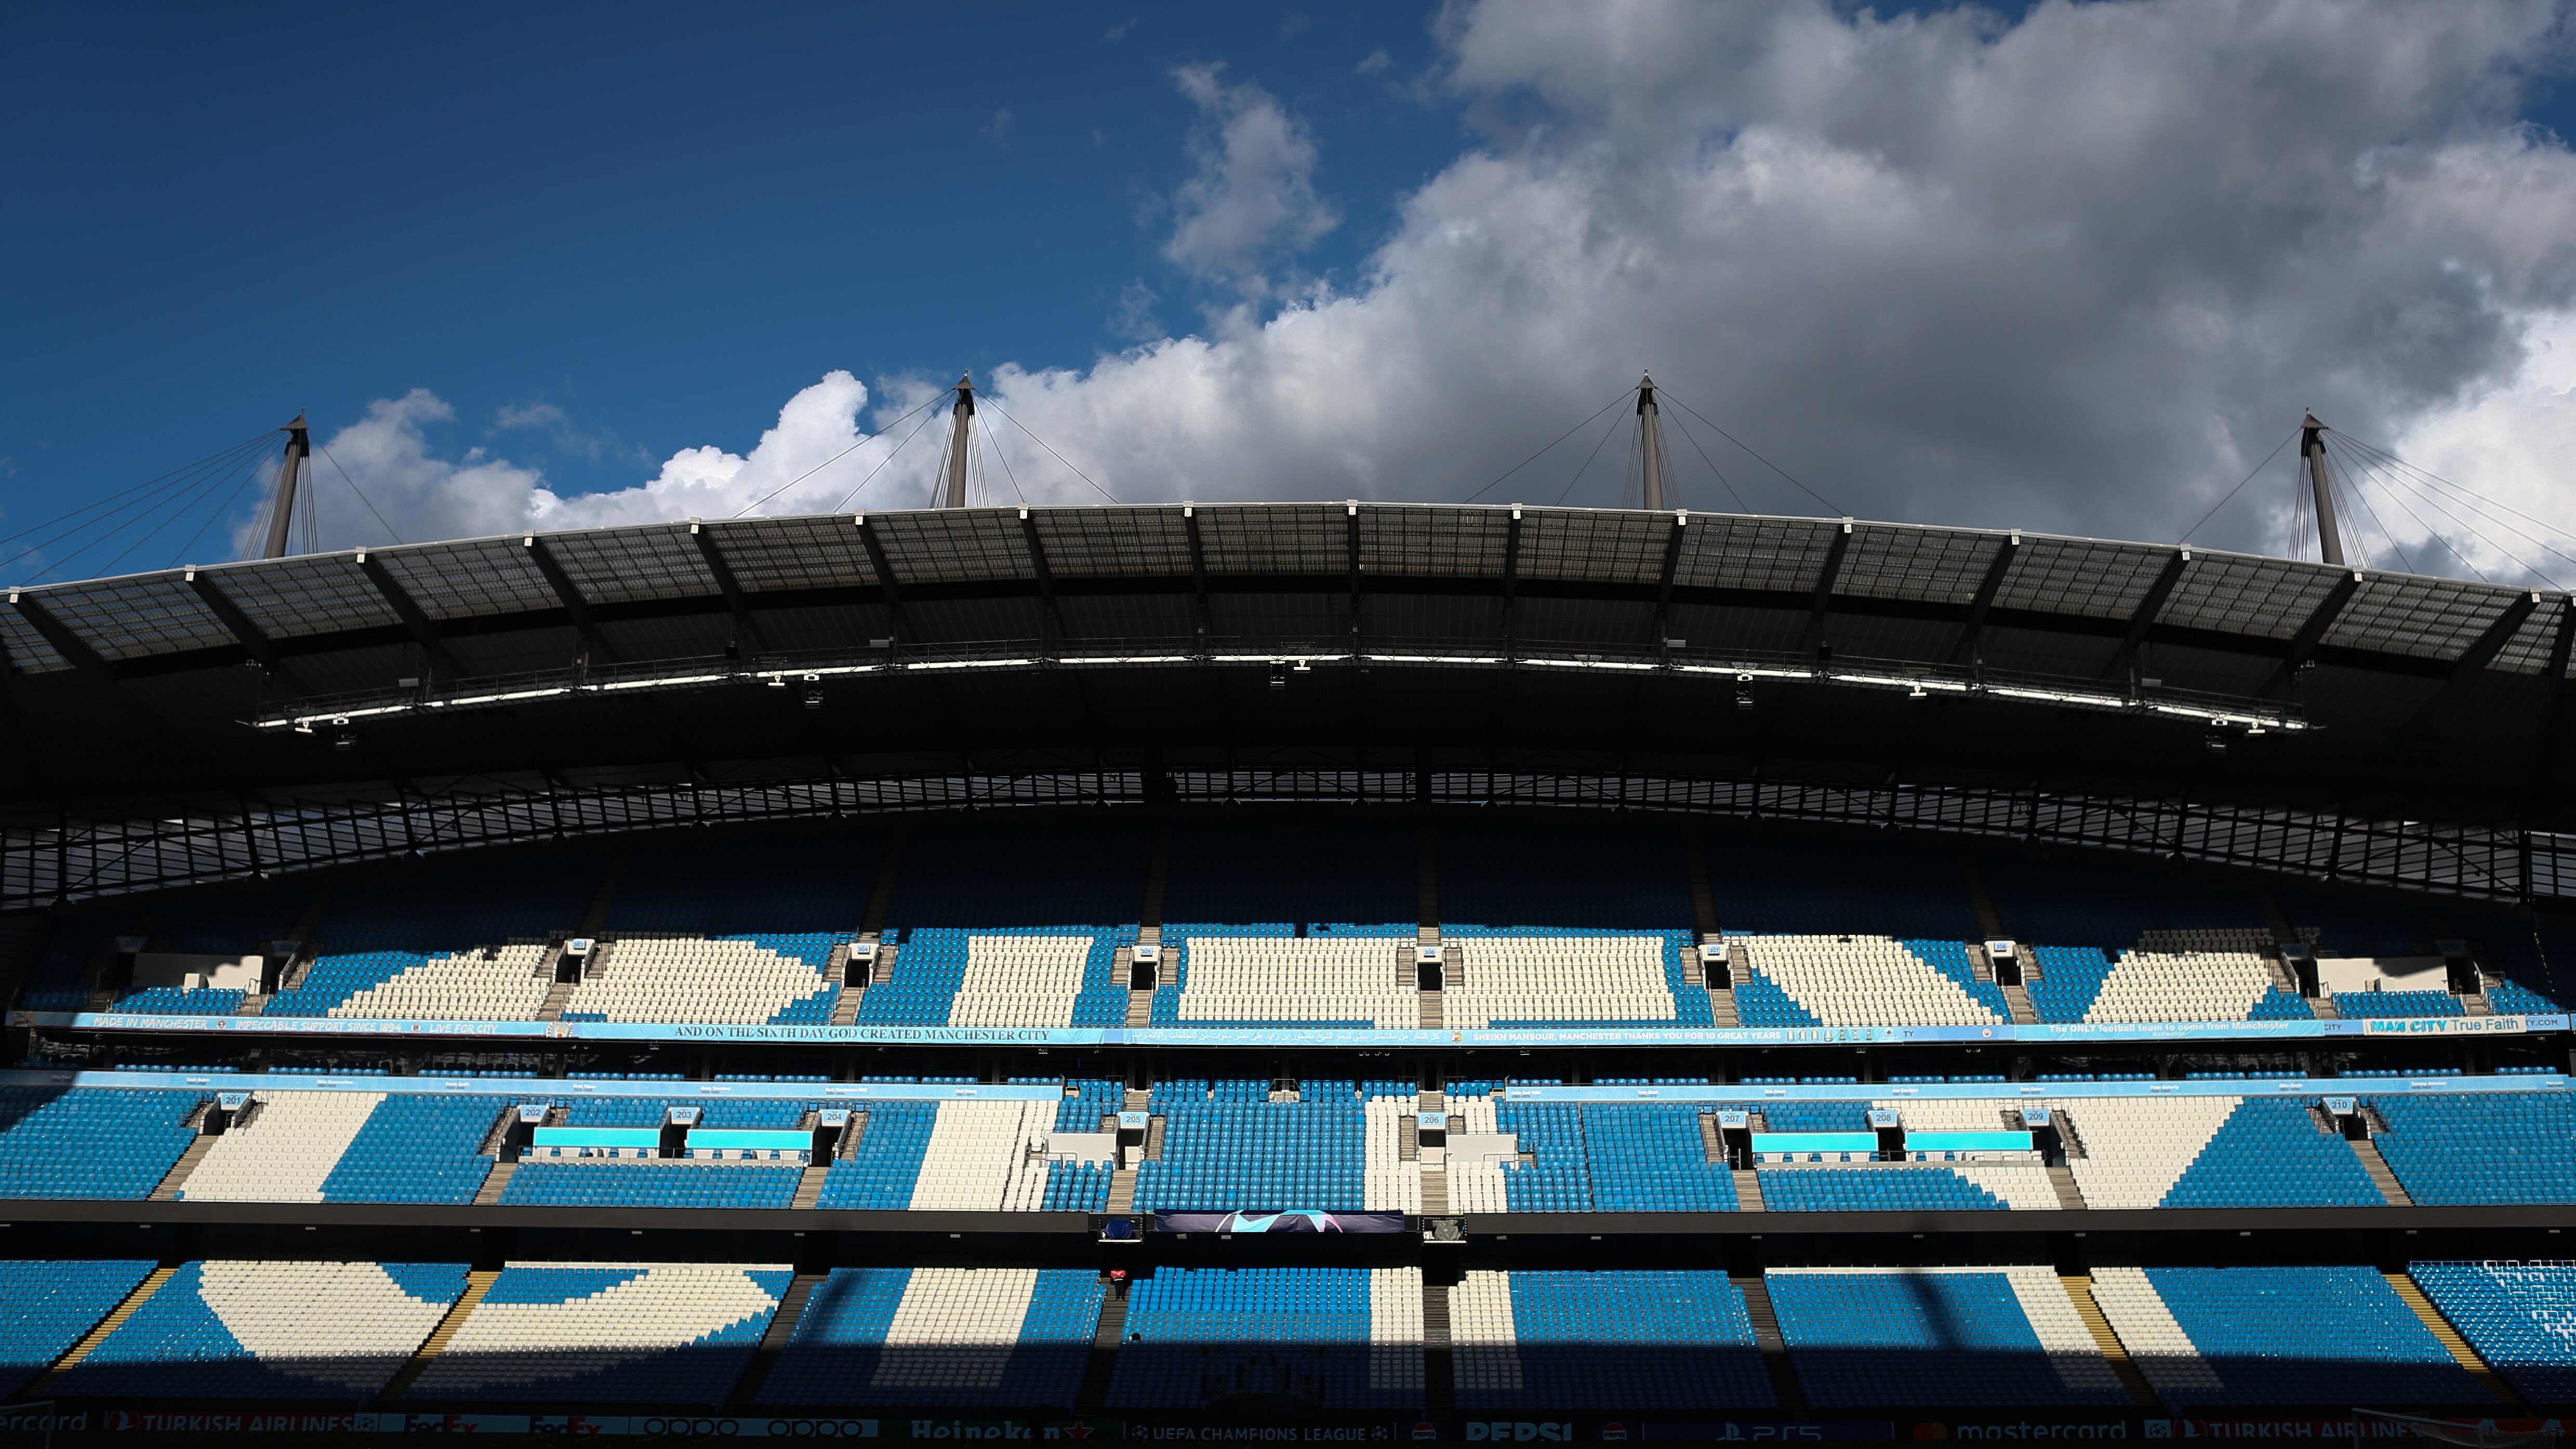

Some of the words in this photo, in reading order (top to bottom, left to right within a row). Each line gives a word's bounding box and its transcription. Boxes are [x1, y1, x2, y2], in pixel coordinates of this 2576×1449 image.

[93, 1017, 122, 1027] MADE
[127, 1018, 137, 1027] IN
[142, 1018, 207, 1029] MANCHESTER
[235, 1020, 297, 1031] IMPECCABLE
[300, 1021, 345, 1031] SUPPORT
[348, 1022, 376, 1032] SINCE
[380, 1023, 401, 1032] 1894
[430, 1023, 452, 1033] LIVE
[455, 1024, 474, 1033] FOR
[477, 1024, 498, 1034] CITY
[2099, 1023, 2136, 1032] football
[2207, 1021, 2229, 1030] from
[2232, 1020, 2289, 1030] Manchester
[2370, 1020, 2406, 1032] MAN
[2410, 1020, 2447, 1032] CITY
[2451, 1019, 2481, 1031] True
[2486, 1018, 2519, 1030] Faith
[675, 1027, 702, 1036] AND
[706, 1028, 724, 1037] ON
[727, 1028, 753, 1038] THE
[757, 1028, 796, 1038] SIXTH
[800, 1029, 825, 1039] DAY
[829, 1029, 857, 1039] GOD
[861, 1029, 921, 1040] CREATED
[925, 1030, 1015, 1040] MANCHESTER
[1018, 1030, 1050, 1041] CITY
[1509, 1033, 1557, 1042] MANSOUR,
[1126, 1115, 1141, 1123] 205
[143, 1415, 241, 1431] TURKISH
[249, 1416, 354, 1431] AIRLINES
[1957, 1420, 2126, 1439] mastercard
[2209, 1423, 2312, 1438] TURKISH
[2320, 1421, 2424, 1438] AIRLINES
[1153, 1427, 1196, 1440] UEFA
[1201, 1428, 1297, 1440] CHAMPIONS
[1304, 1428, 1366, 1441] LEAGUE
[1466, 1422, 1573, 1441] PEPSI
[1752, 1426, 1822, 1441] PS5
